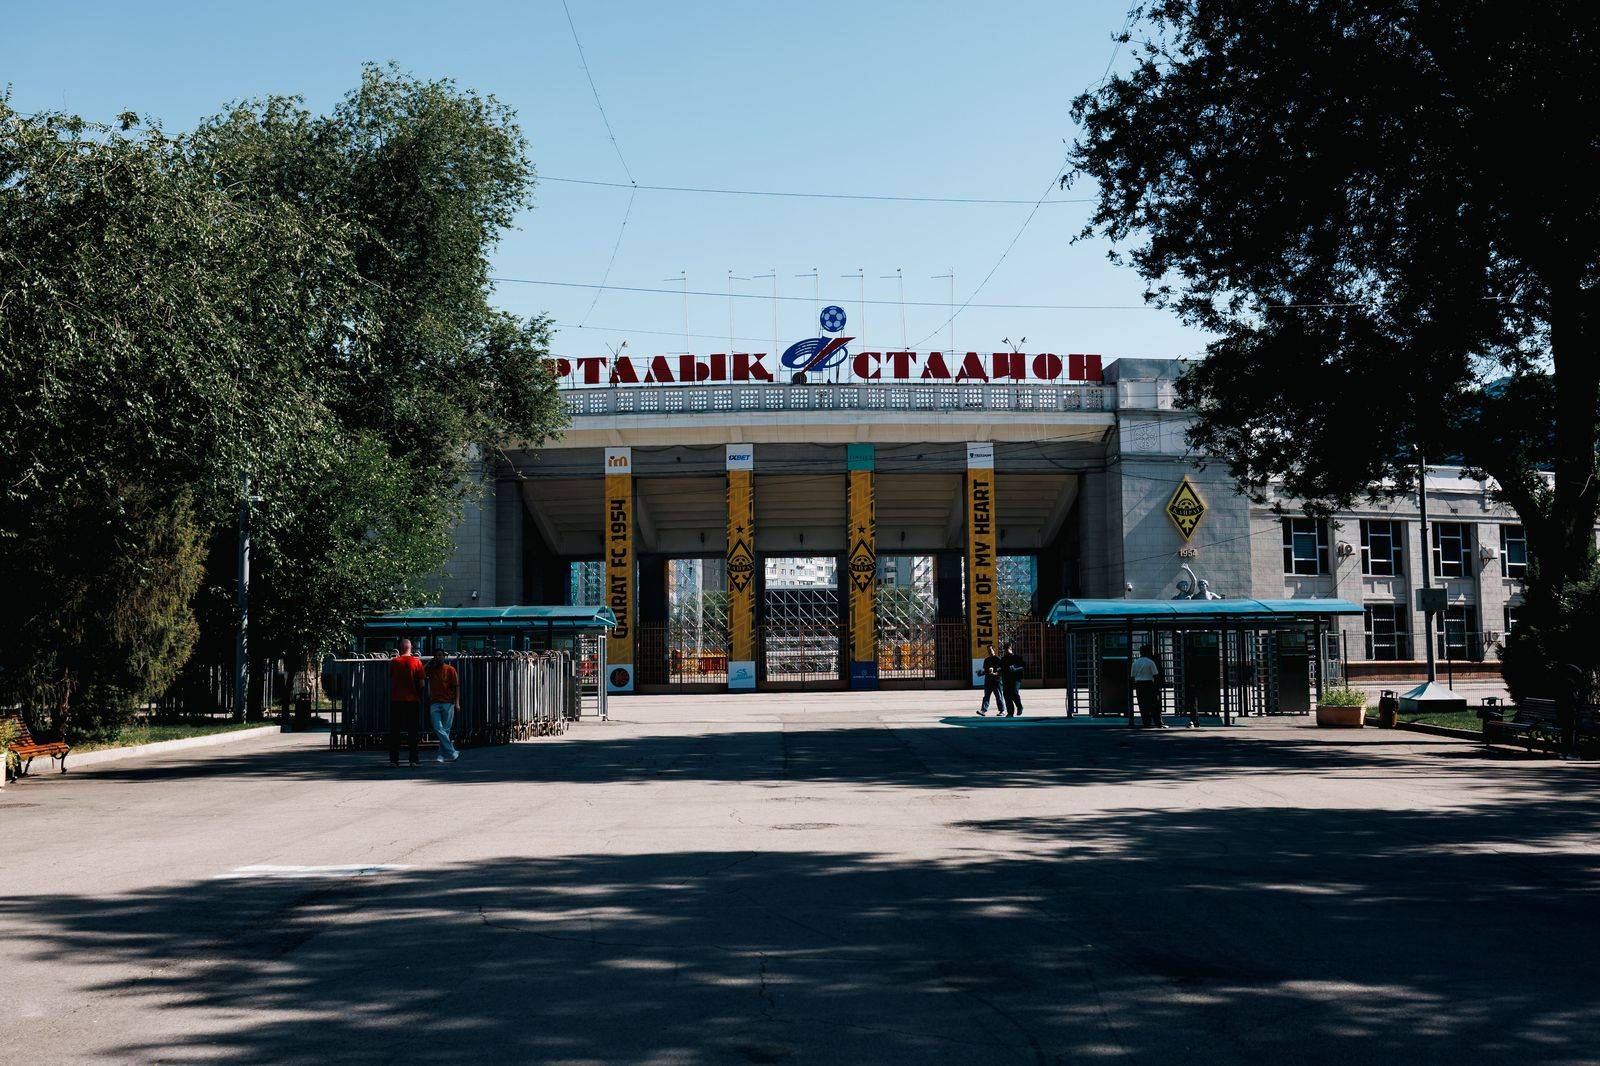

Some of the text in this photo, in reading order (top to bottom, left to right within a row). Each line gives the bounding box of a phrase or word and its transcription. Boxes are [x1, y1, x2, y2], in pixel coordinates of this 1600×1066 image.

[541, 351, 1102, 385] РТАЛЫҚ СТАДИОН
[611, 499, 627, 541] 1954
[611, 549, 627, 567] FC
[974, 479, 993, 648] TEAM OF MY HEART
